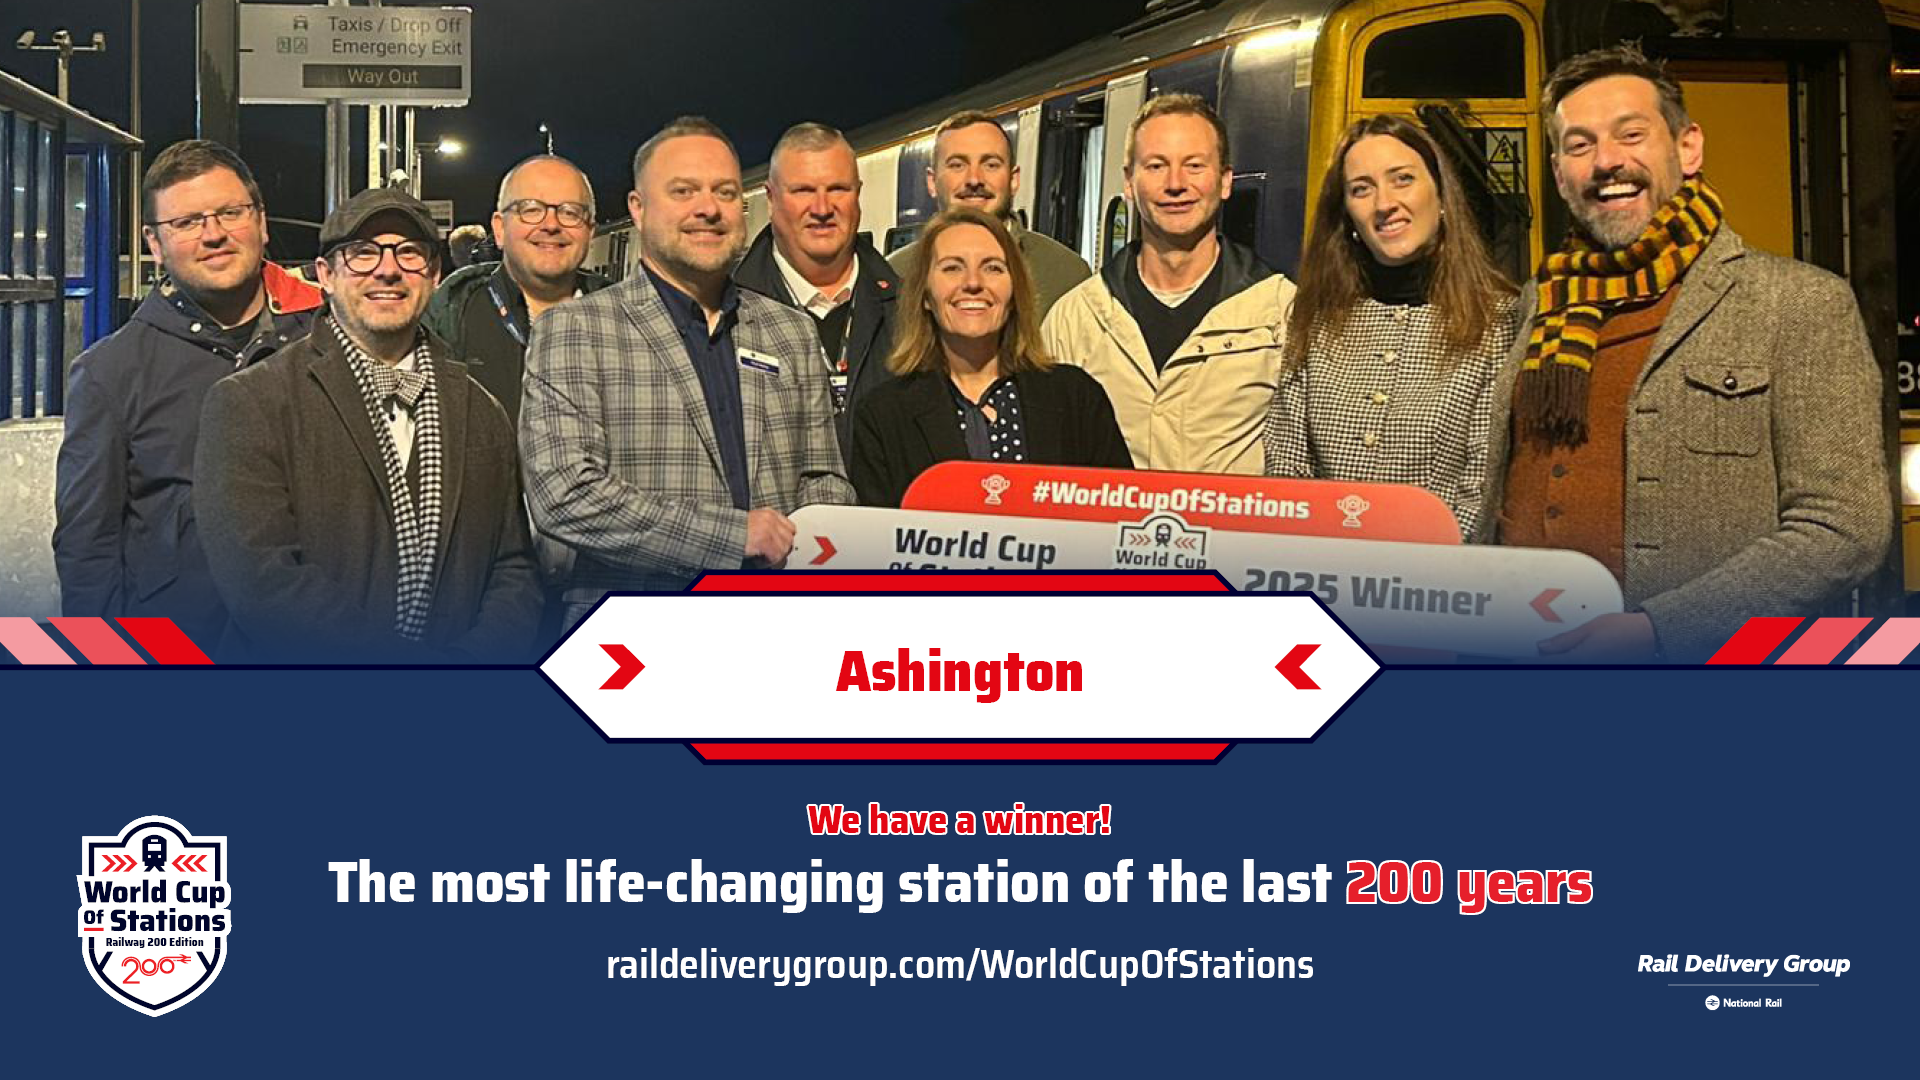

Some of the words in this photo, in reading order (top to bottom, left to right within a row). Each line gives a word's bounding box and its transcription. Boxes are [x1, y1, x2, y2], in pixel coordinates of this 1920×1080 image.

[327, 16, 373, 33] Taxis
[377, 17, 385, 33] /
[391, 17, 430, 36] Drop
[436, 17, 463, 33] Off
[332, 39, 426, 57] Emergency
[432, 40, 463, 55] Exit
[348, 68, 384, 86] Way
[389, 69, 418, 83] Out
[1033, 481, 1310, 519] #WorldCupOfStations
[895, 528, 989, 560] World
[998, 535, 1056, 569] Cup
[1116, 549, 1169, 567] World
[1174, 553, 1207, 569] Cup
[1244, 568, 1338, 604] 2025
[1351, 575, 1492, 616] Winner
